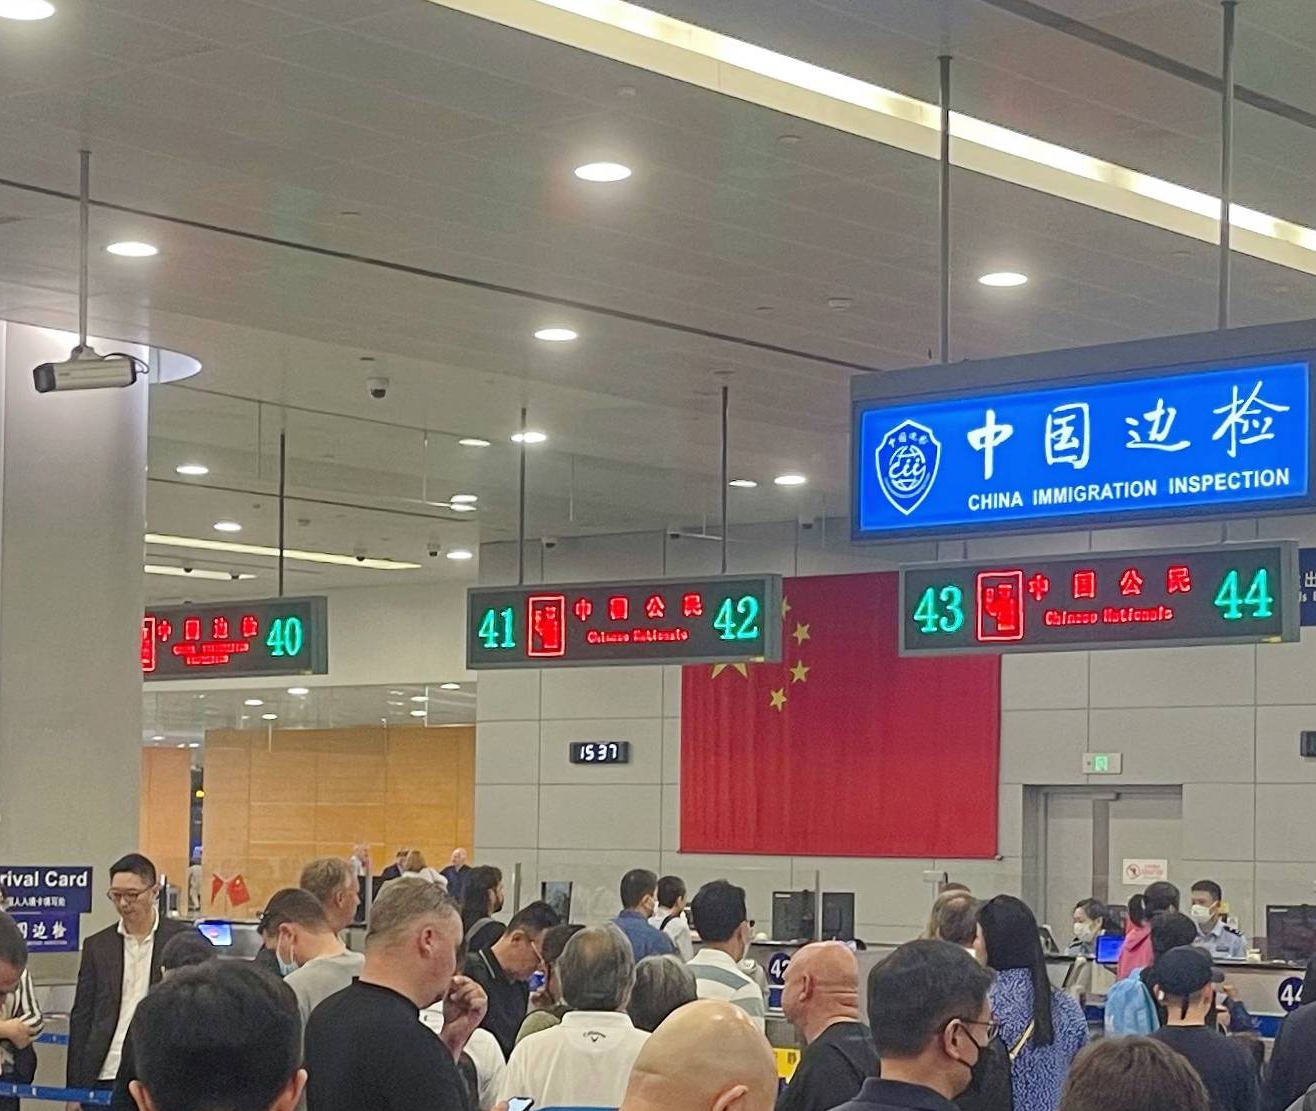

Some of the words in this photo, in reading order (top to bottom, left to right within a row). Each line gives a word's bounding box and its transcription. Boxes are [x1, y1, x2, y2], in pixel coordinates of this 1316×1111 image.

[967, 381, 1290, 480] 中国边检
[967, 490, 1024, 511] CHINA
[1032, 479, 1157, 506] IMMIGRATION
[1168, 467, 1290, 495] INSPECTION
[1028, 566, 1192, 601] 中国公民
[1213, 567, 1274, 619] 44
[478, 607, 516, 649] 41
[575, 594, 703, 621] 中国公民
[713, 595, 759, 640] 42
[912, 585, 965, 633] 43
[1044, 610, 1098, 627] Chinese
[266, 616, 303, 656] 40
[44, 870, 88, 887] Card
